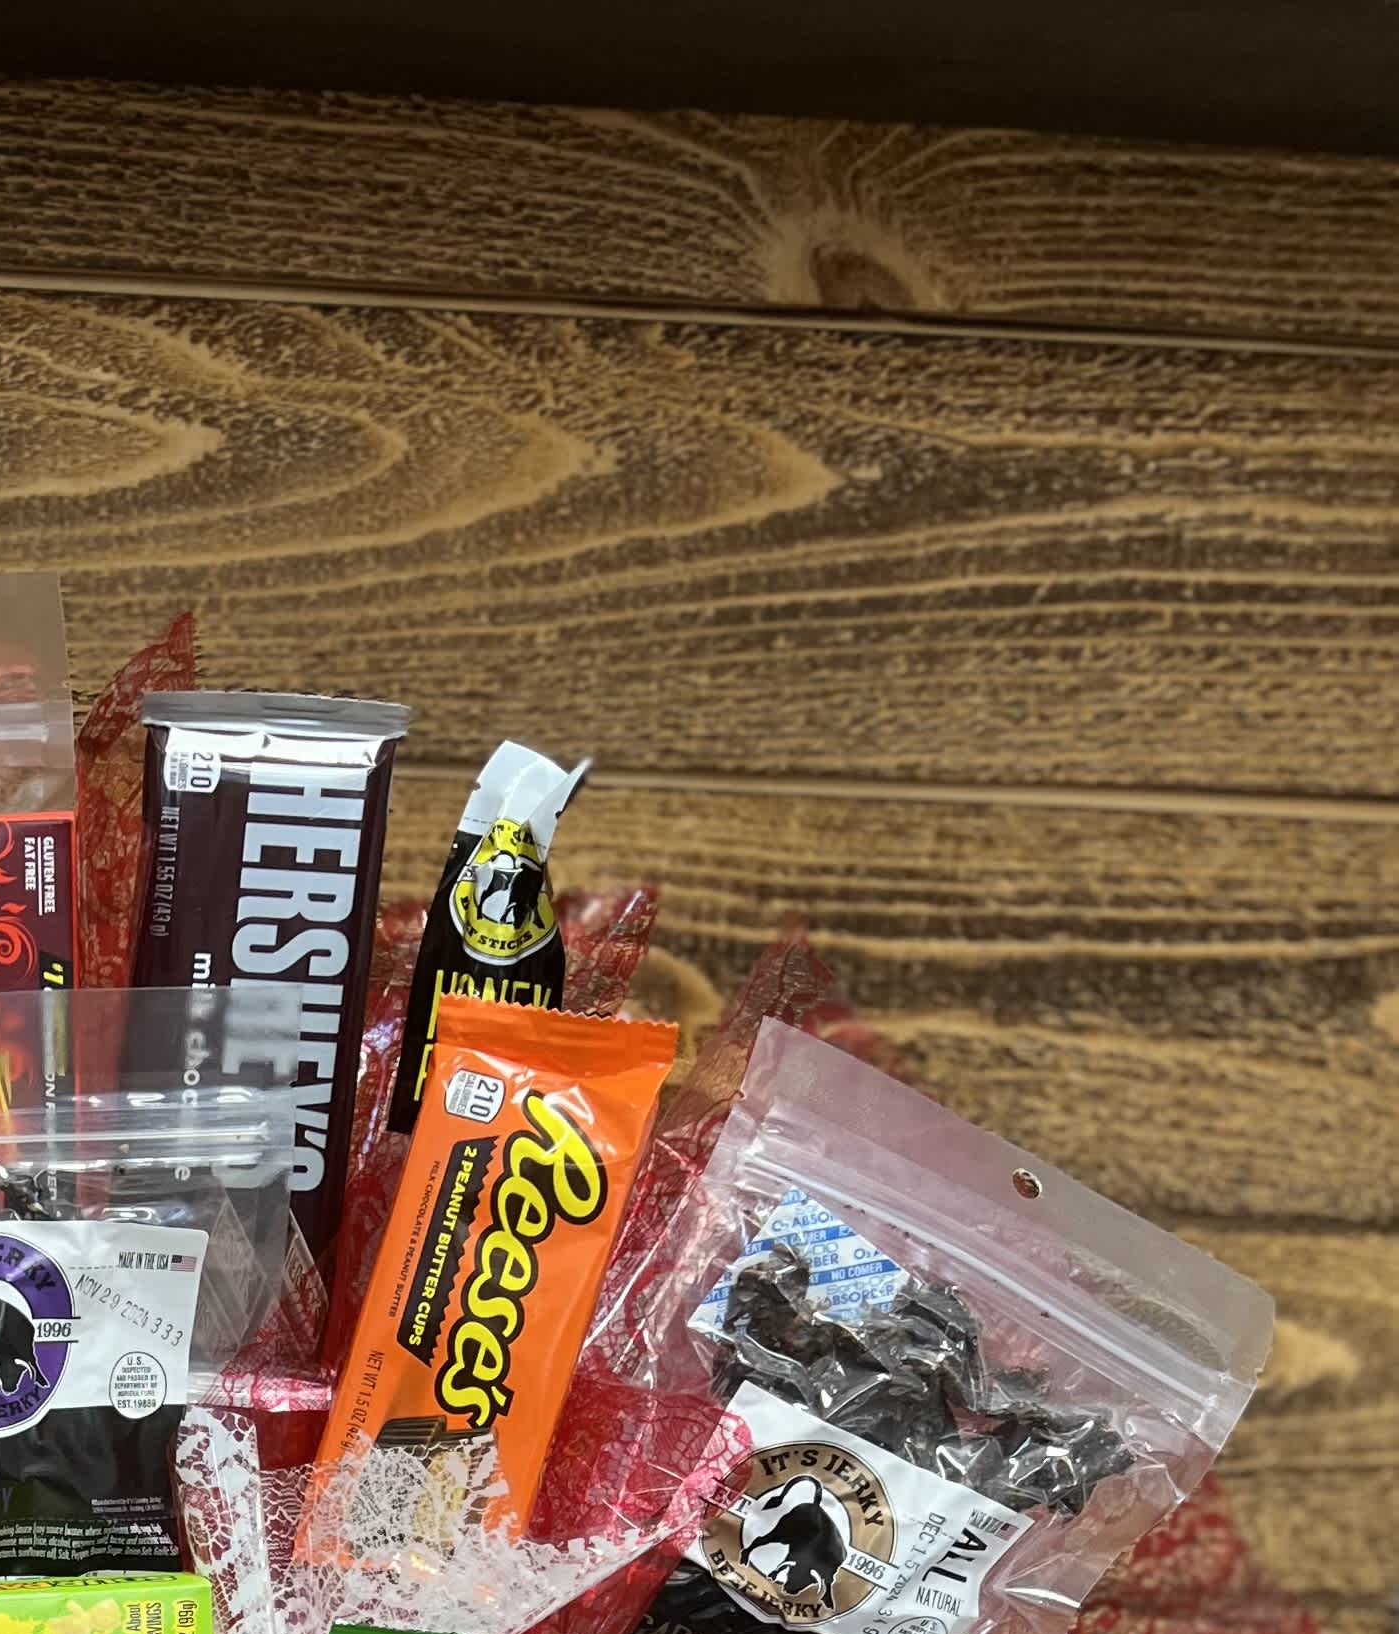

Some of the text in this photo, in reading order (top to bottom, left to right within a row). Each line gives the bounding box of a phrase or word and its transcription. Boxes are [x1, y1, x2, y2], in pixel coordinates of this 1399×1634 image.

[24, 837, 36, 890] FAT FREE
[43, 836, 55, 913] GLUTEN FREE
[470, 1080, 499, 1117] 210
[409, 1145, 477, 1347] 2 PEANUT BUTTER CUPS
[119, 1252, 169, 1270] MADE IN THE USA
[439, 1092, 604, 1428] Reese's
[75, 1273, 101, 1301] NOV
[36, 1322, 73, 1339] 1996
[127, 1356, 144, 1366] U.S.
[366, 1350, 385, 1371] NET
[361, 1372, 378, 1390] WT
[351, 1408, 367, 1424] OZ
[759, 1449, 884, 1526] IT'S JERKY
[918, 1512, 946, 1543] DEC
[847, 1553, 886, 1580] 1996
[922, 1528, 987, 1582] ALL
[177, 1600, 197, 1627] (99g)
[761, 1590, 824, 1617] JERKY
[916, 1586, 961, 1616] NATURAL
[126, 1604, 141, 1631] About
